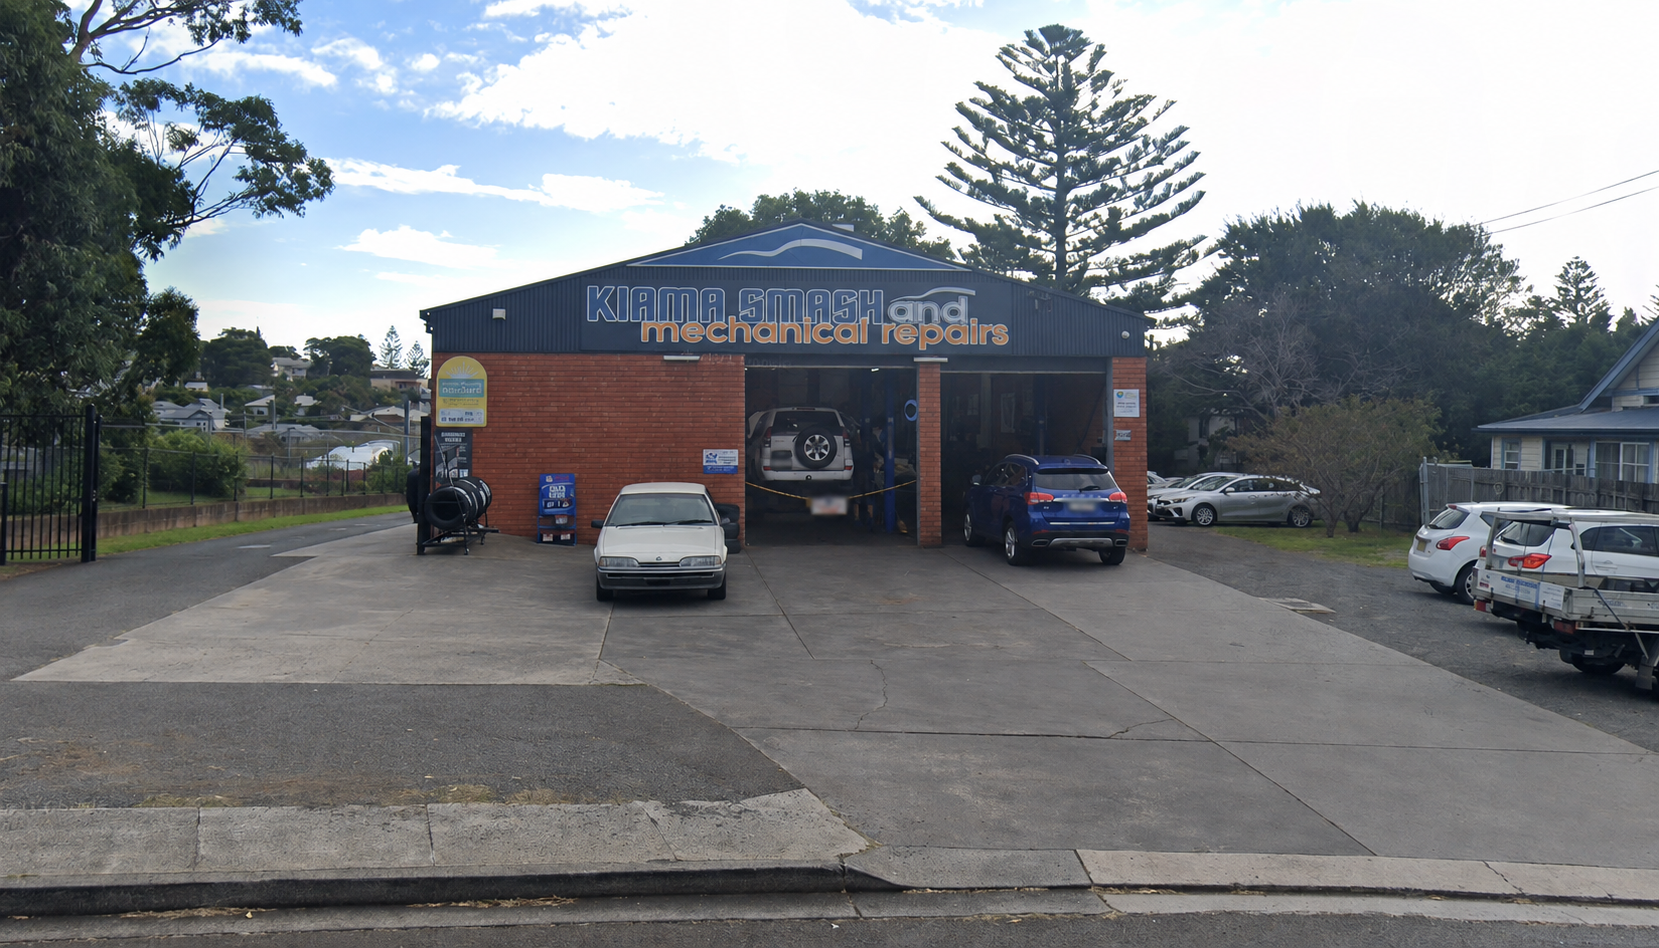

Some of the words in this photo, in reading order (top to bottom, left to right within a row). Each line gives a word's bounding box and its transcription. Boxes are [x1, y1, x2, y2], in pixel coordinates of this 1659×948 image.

[587, 285, 726, 323] KIAMA
[739, 288, 883, 325] SMASH
[887, 295, 969, 325] and
[641, 315, 869, 345] mechanical
[882, 317, 1010, 351] repairs
